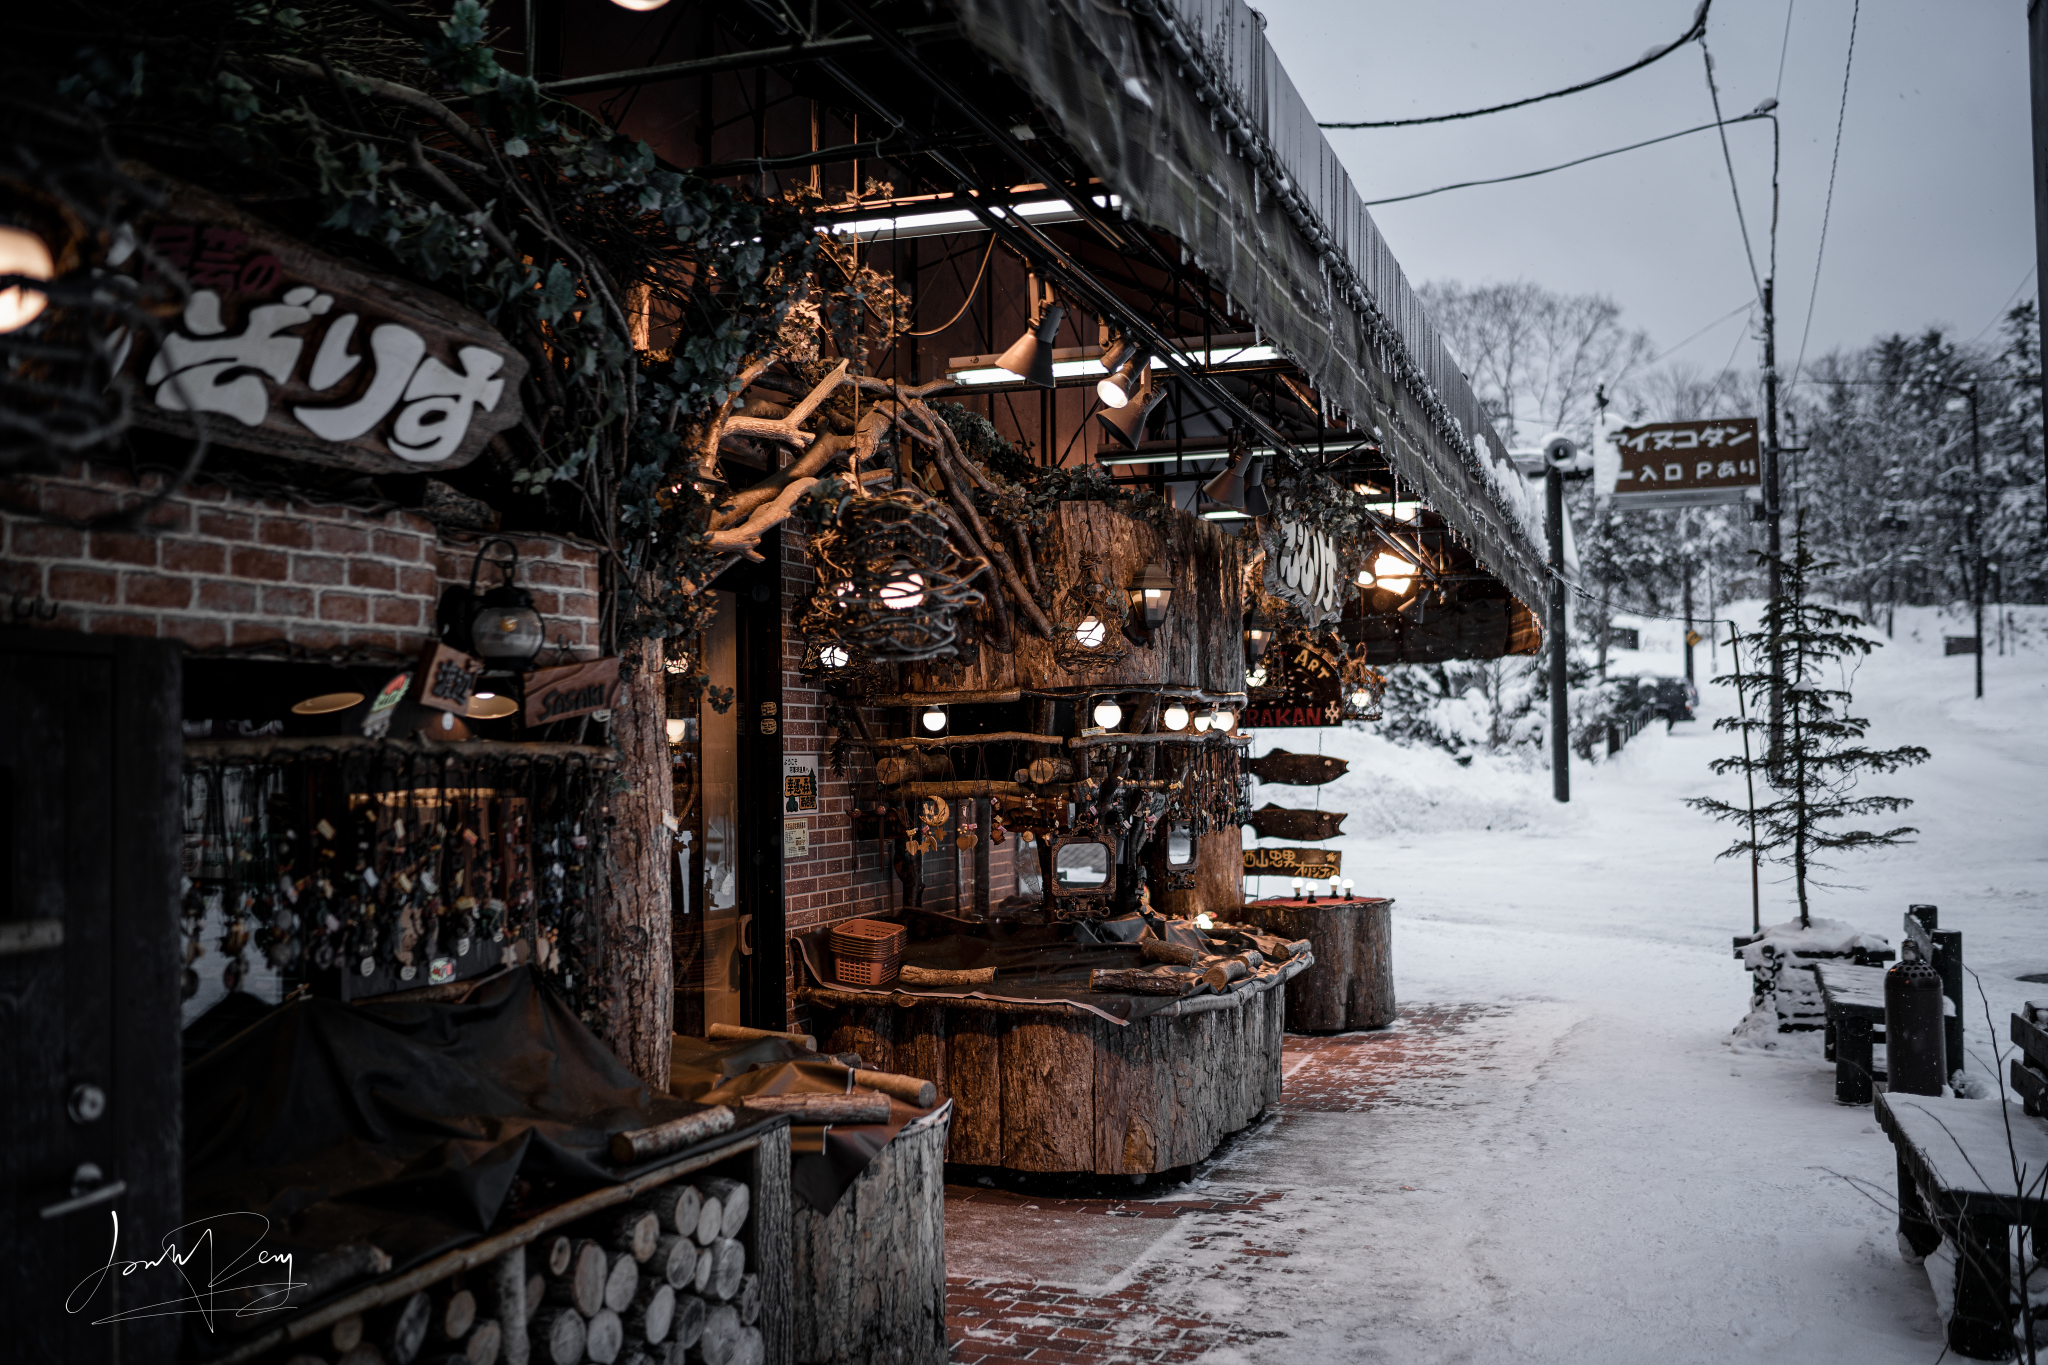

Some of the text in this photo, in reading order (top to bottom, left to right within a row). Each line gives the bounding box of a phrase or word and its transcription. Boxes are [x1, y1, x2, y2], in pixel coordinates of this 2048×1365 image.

[1608, 426, 1752, 452] アイヌコタン
[1293, 648, 1331, 679] ART
[538, 684, 606, 721] SASAKI
[1245, 707, 1321, 728] RAKAN
[784, 758, 798, 766] ようこそ
[1004, 807, 1056, 829] Suzuki
[1243, 849, 1296, 868] 西山忠男
